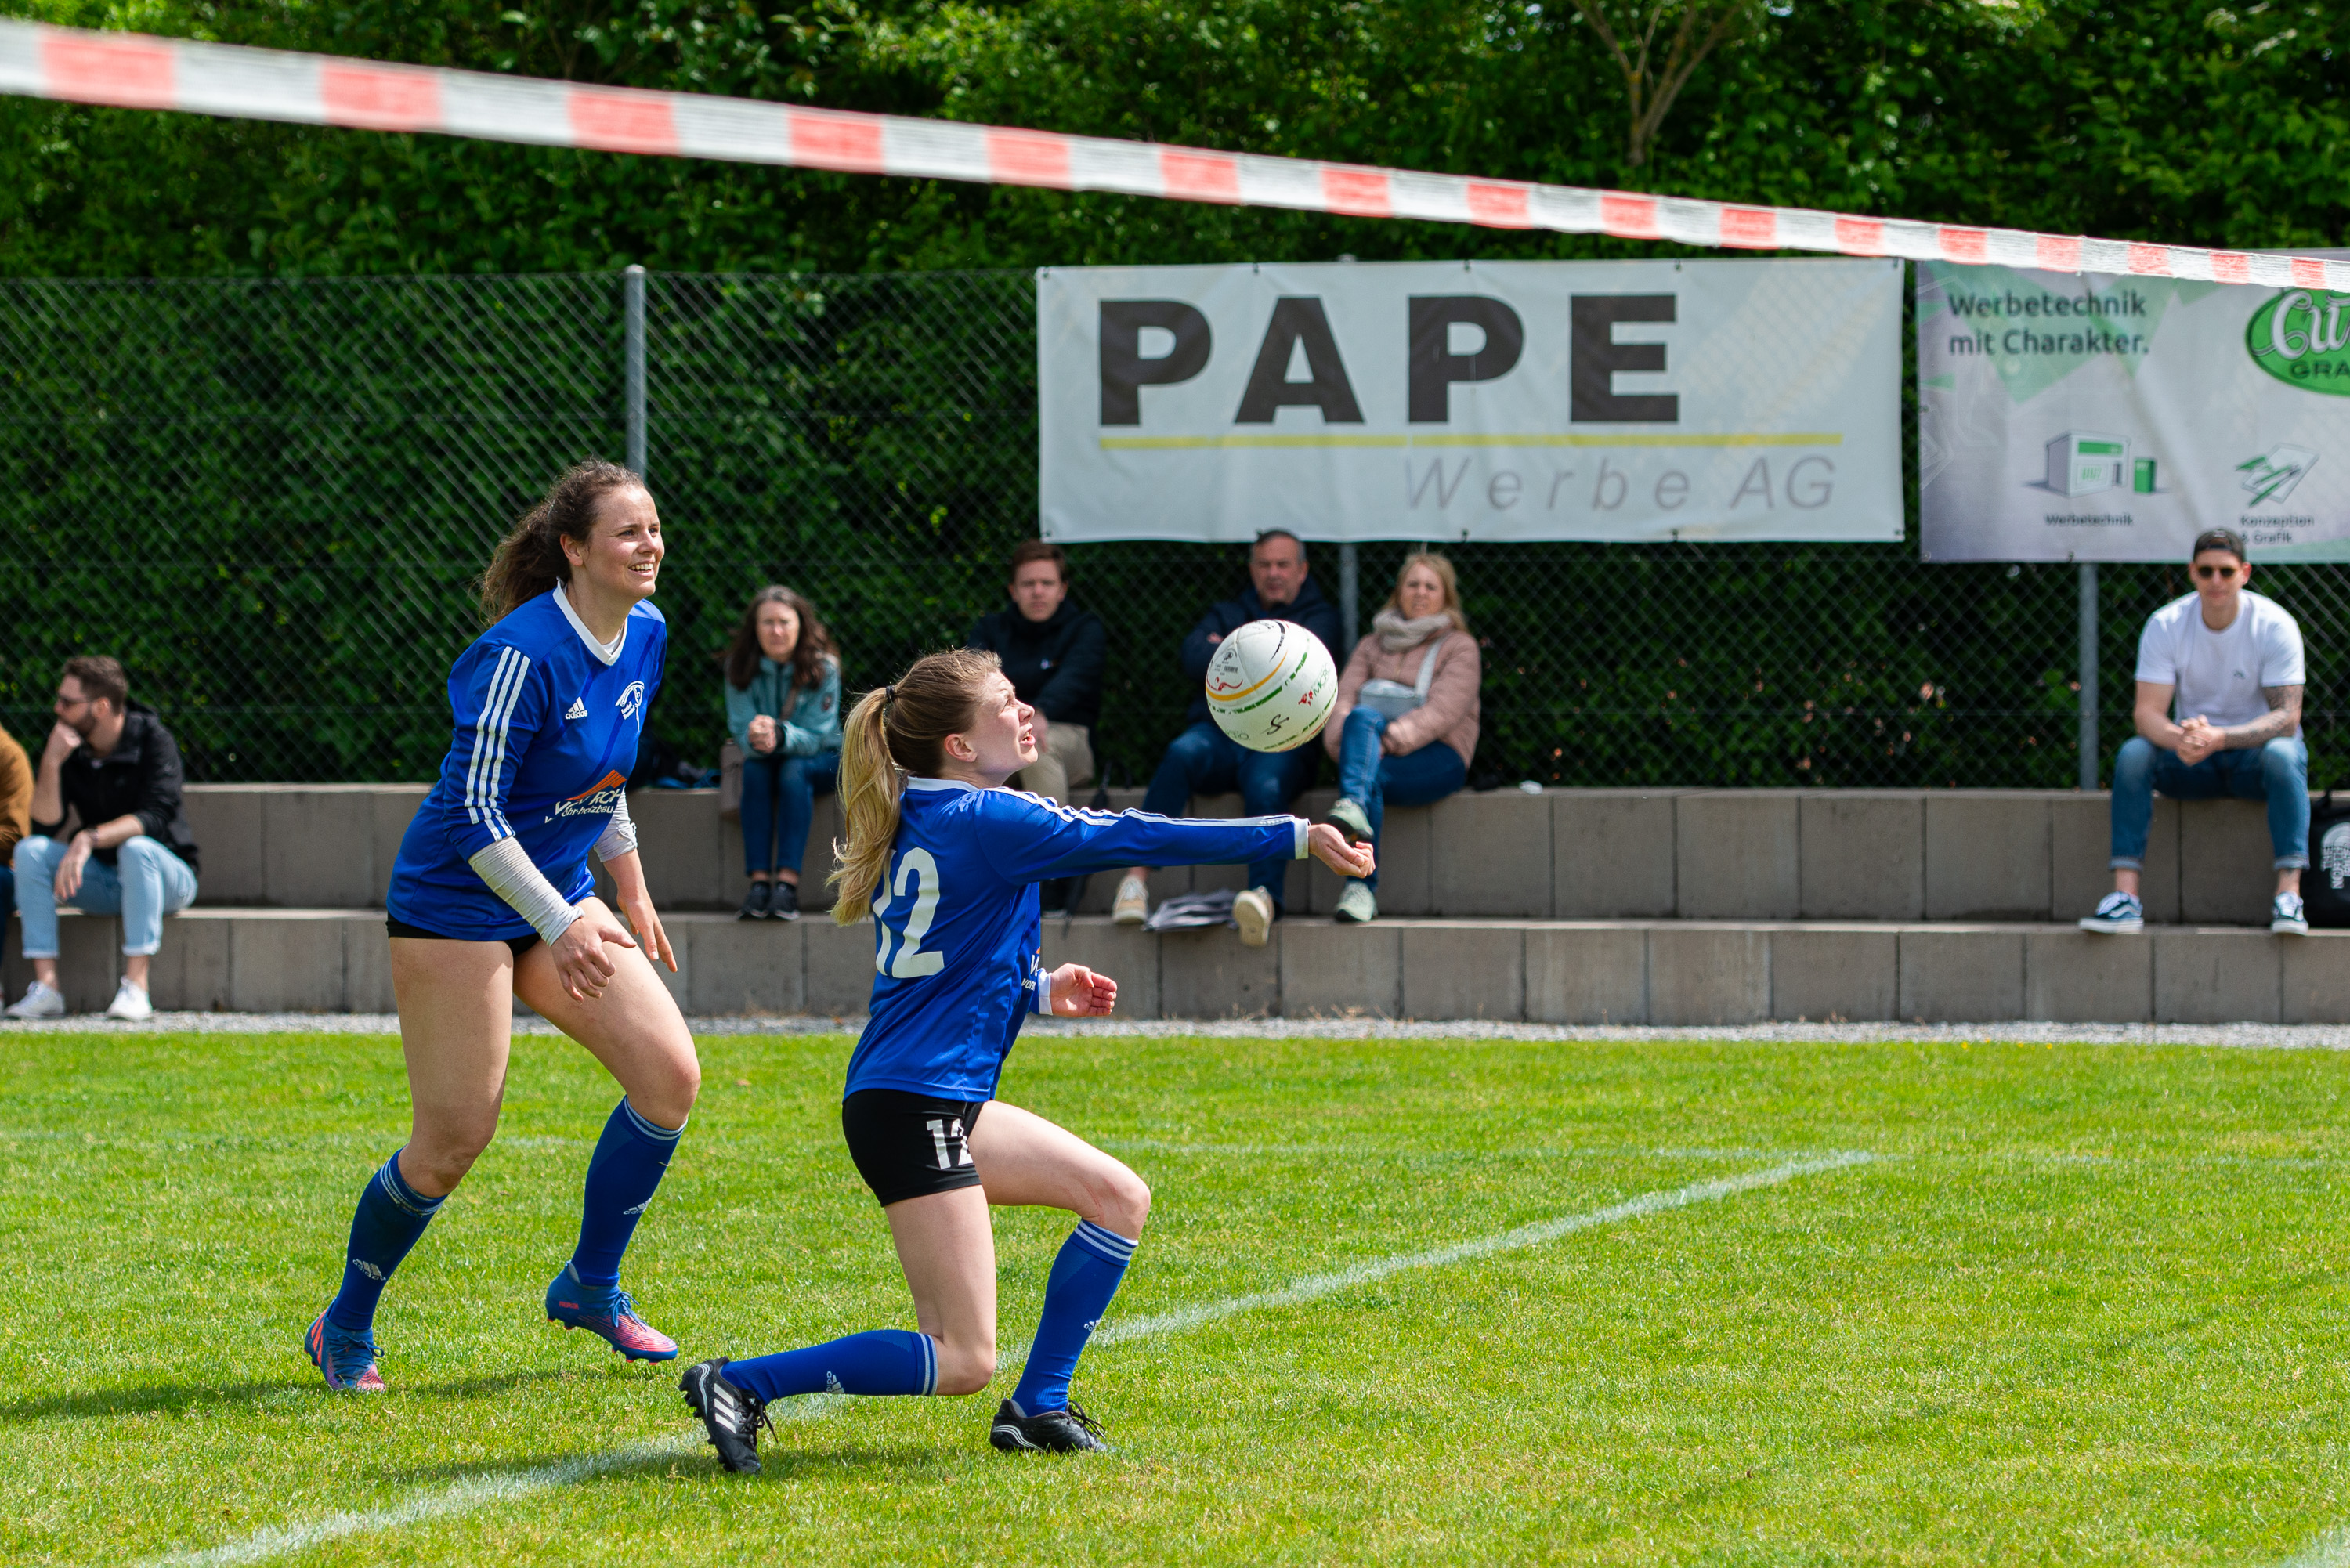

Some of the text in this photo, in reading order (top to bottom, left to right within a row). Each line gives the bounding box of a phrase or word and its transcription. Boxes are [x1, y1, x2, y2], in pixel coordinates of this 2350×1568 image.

[1948, 288, 2147, 317] Werbetechnik
[1950, 327, 2149, 355] mit Charakter.
[1099, 293, 1679, 426] PAPE
[2290, 360, 2350, 380] GRA
[1408, 456, 1836, 511] Werbe AG
[2044, 512, 2133, 526] Werbetechnik
[2240, 514, 2315, 528] Konzeption
[2254, 530, 2292, 544] Grafik
[566, 710, 588, 719] adidas
[873, 847, 945, 978] 12
[927, 1119, 973, 1169] 12
